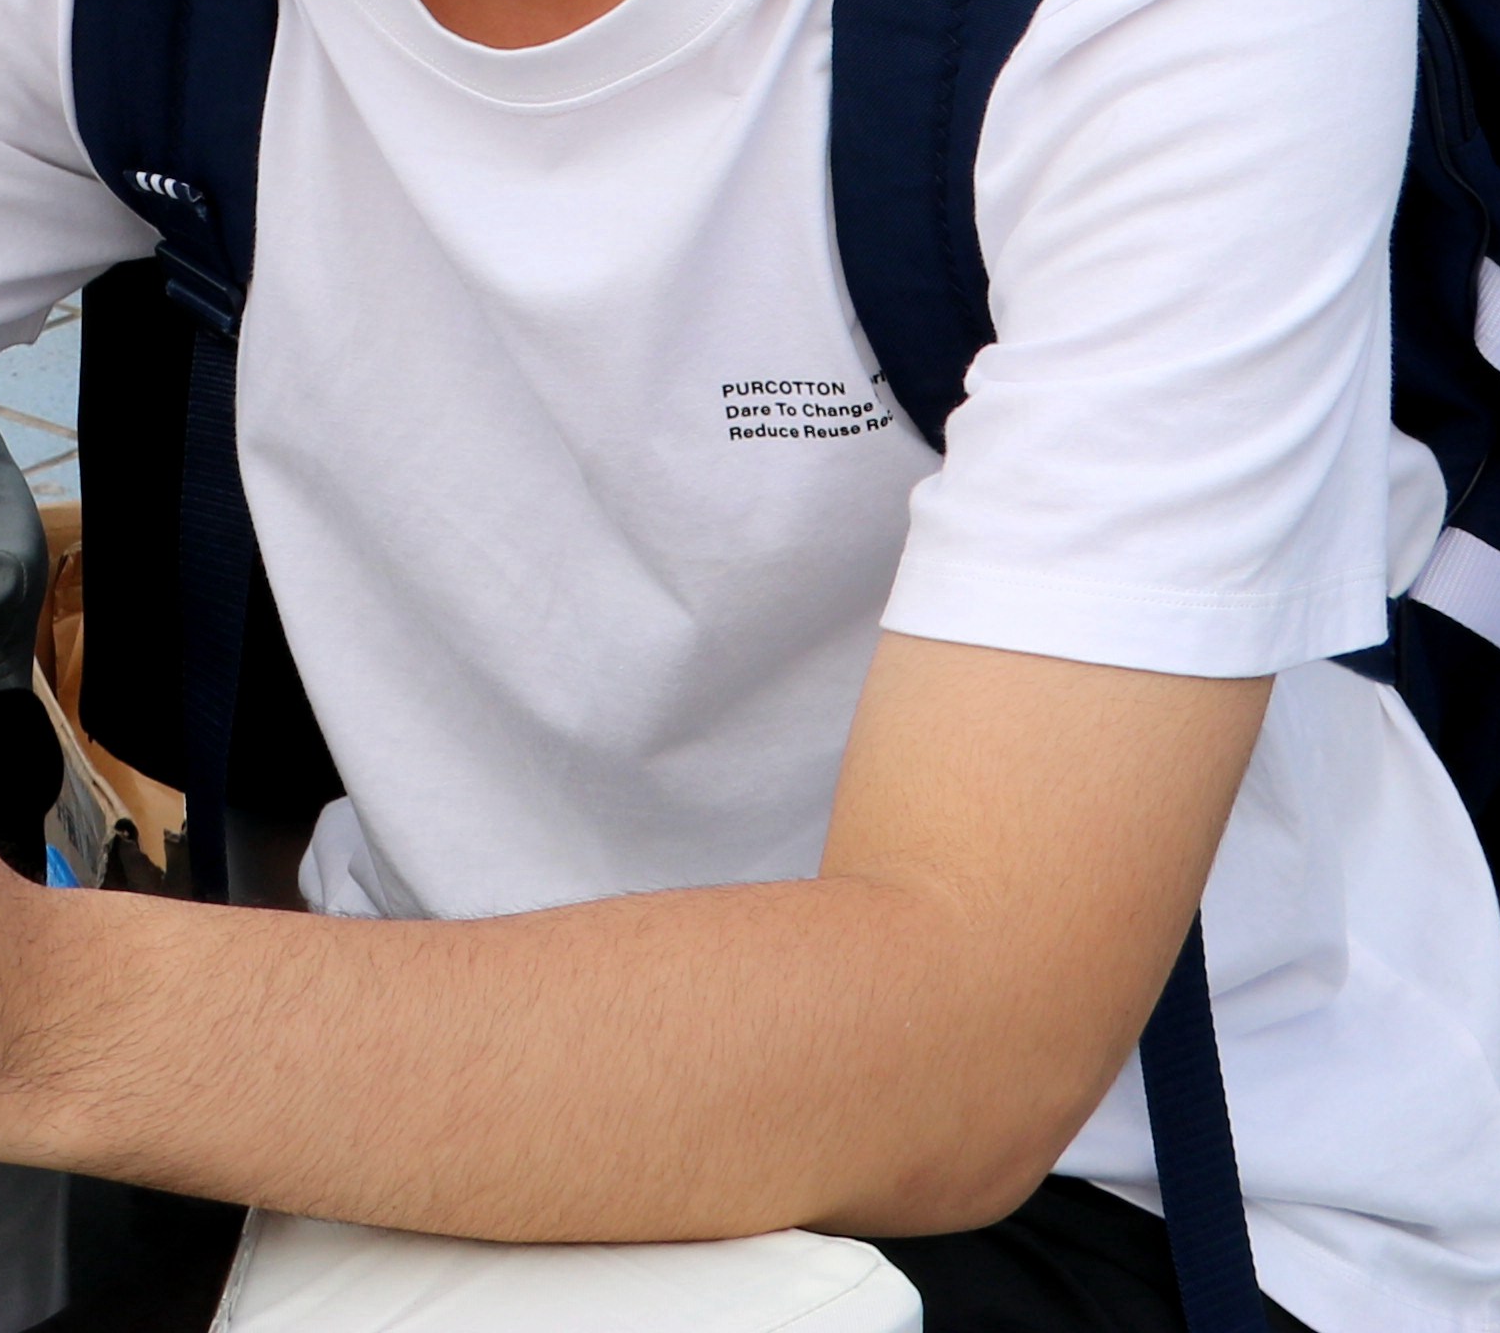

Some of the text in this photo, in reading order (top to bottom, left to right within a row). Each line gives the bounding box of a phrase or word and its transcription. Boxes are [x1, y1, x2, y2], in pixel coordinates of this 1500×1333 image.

[722, 380, 846, 398] PURCOTTON
[725, 401, 874, 419] Dare To Change
[729, 423, 800, 441] Reduce
[803, 423, 861, 439] Reuse
